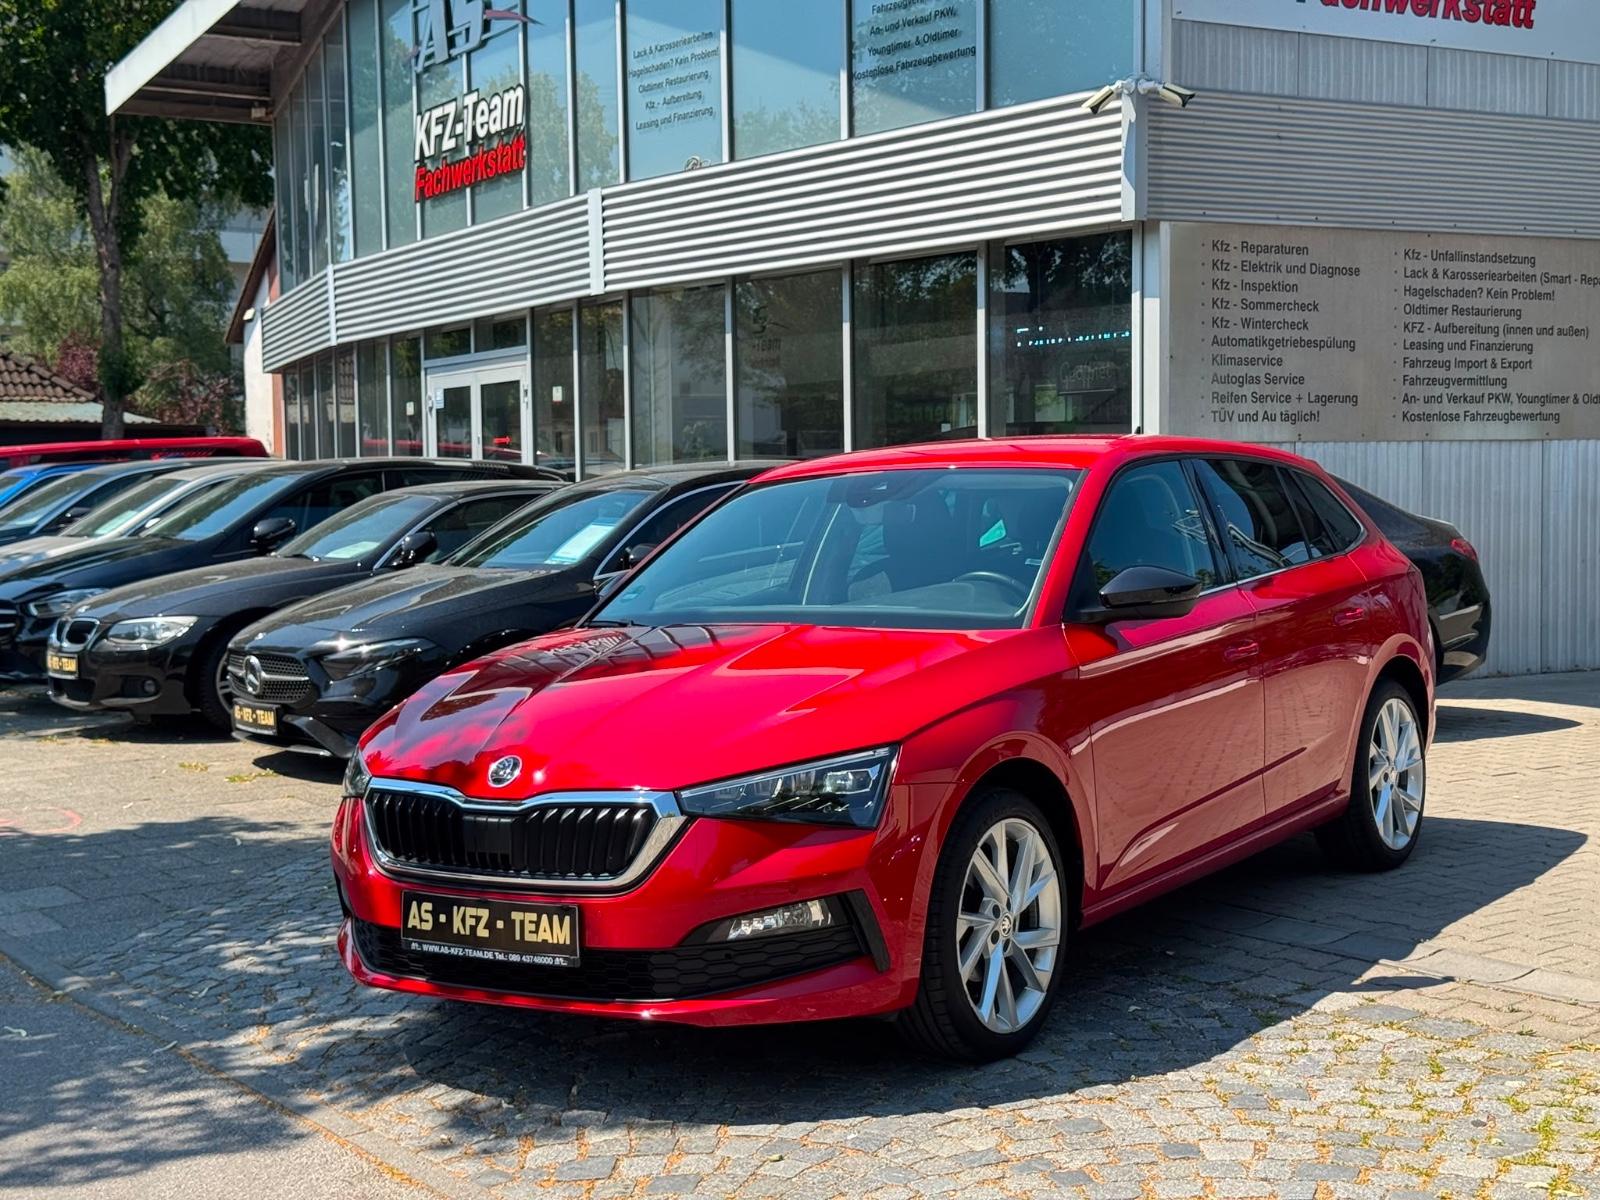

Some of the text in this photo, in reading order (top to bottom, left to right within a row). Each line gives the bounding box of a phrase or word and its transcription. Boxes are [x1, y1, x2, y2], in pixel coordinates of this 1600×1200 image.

[885, 21, 900, 32] und
[902, 12, 932, 28] Verkauf
[868, 28, 958, 56] Youngtimer & Oldtimer
[633, 45, 646, 59] Lack
[675, 56, 689, 66] Kein
[691, 46, 719, 61] Problem!
[853, 46, 976, 81] Kostenlose Fahrzeugbewertung
[665, 70, 708, 87] Restaurierung
[663, 91, 702, 106] Aufbereitung
[415, 84, 524, 161] KFZ-Team
[636, 107, 713, 130] Leasing und Finanzierung
[415, 132, 525, 203] Fachwerkstatt
[1211, 239, 1230, 252] Kfz
[1241, 241, 1309, 256] Reparaturen
[1404, 249, 1421, 261] Kfz
[1431, 249, 1536, 268] Unfallinstandsetzung
[1211, 259, 1230, 272] Kfz
[1241, 261, 1282, 273] Elektrik
[1286, 263, 1306, 274] und
[1310, 263, 1361, 278] Diagnose
[1404, 267, 1428, 279] Lack
[1432, 269, 1439, 280] &
[1443, 269, 1536, 283] Karosseriearbeiten
[1540, 272, 1571, 286] (Smart
[1211, 278, 1230, 291] Kfz
[1241, 279, 1298, 294] Inspektion
[1404, 285, 1555, 301] Hagelschaden? Kein Problem!
[1211, 297, 1230, 310] Kfz
[1241, 298, 1319, 312] Sommercheck
[1404, 304, 1522, 320] Oldtimer Restaurierung
[1211, 317, 1230, 329] Kfz
[1241, 318, 1309, 331] Wintercheck
[1404, 322, 1424, 334] KFZ
[1434, 322, 1499, 337] Aufbereitung
[1503, 324, 1533, 337] (innen
[1536, 325, 1553, 336] und
[1557, 326, 1589, 339] außen)
[1211, 335, 1356, 352] Automatikgetriebespülung
[1403, 339, 1533, 354] Leasing und Finanzierung
[1211, 354, 1283, 367] Klimaservice
[1403, 357, 1532, 372] Fahrzeug Import & Export
[1211, 373, 1305, 388] Autoglas Service
[1403, 375, 1507, 389] Fahrzeugvermittlung
[1211, 392, 1247, 404] Reifen
[1251, 392, 1292, 404] Service
[1308, 392, 1358, 406] Lagerung
[1402, 393, 1420, 404] An-
[1424, 393, 1443, 404] und
[1446, 393, 1485, 405] Verkauf
[1488, 393, 1513, 406] PKW,
[1516, 393, 1569, 407] Youngtimer
[1573, 394, 1579, 405] &
[1211, 408, 1320, 425] TÜV und Au täglich!
[1402, 411, 1560, 424] Kostenlose Fahrzeugbewertung
[407, 901, 570, 944] AS KFZ TEAM
